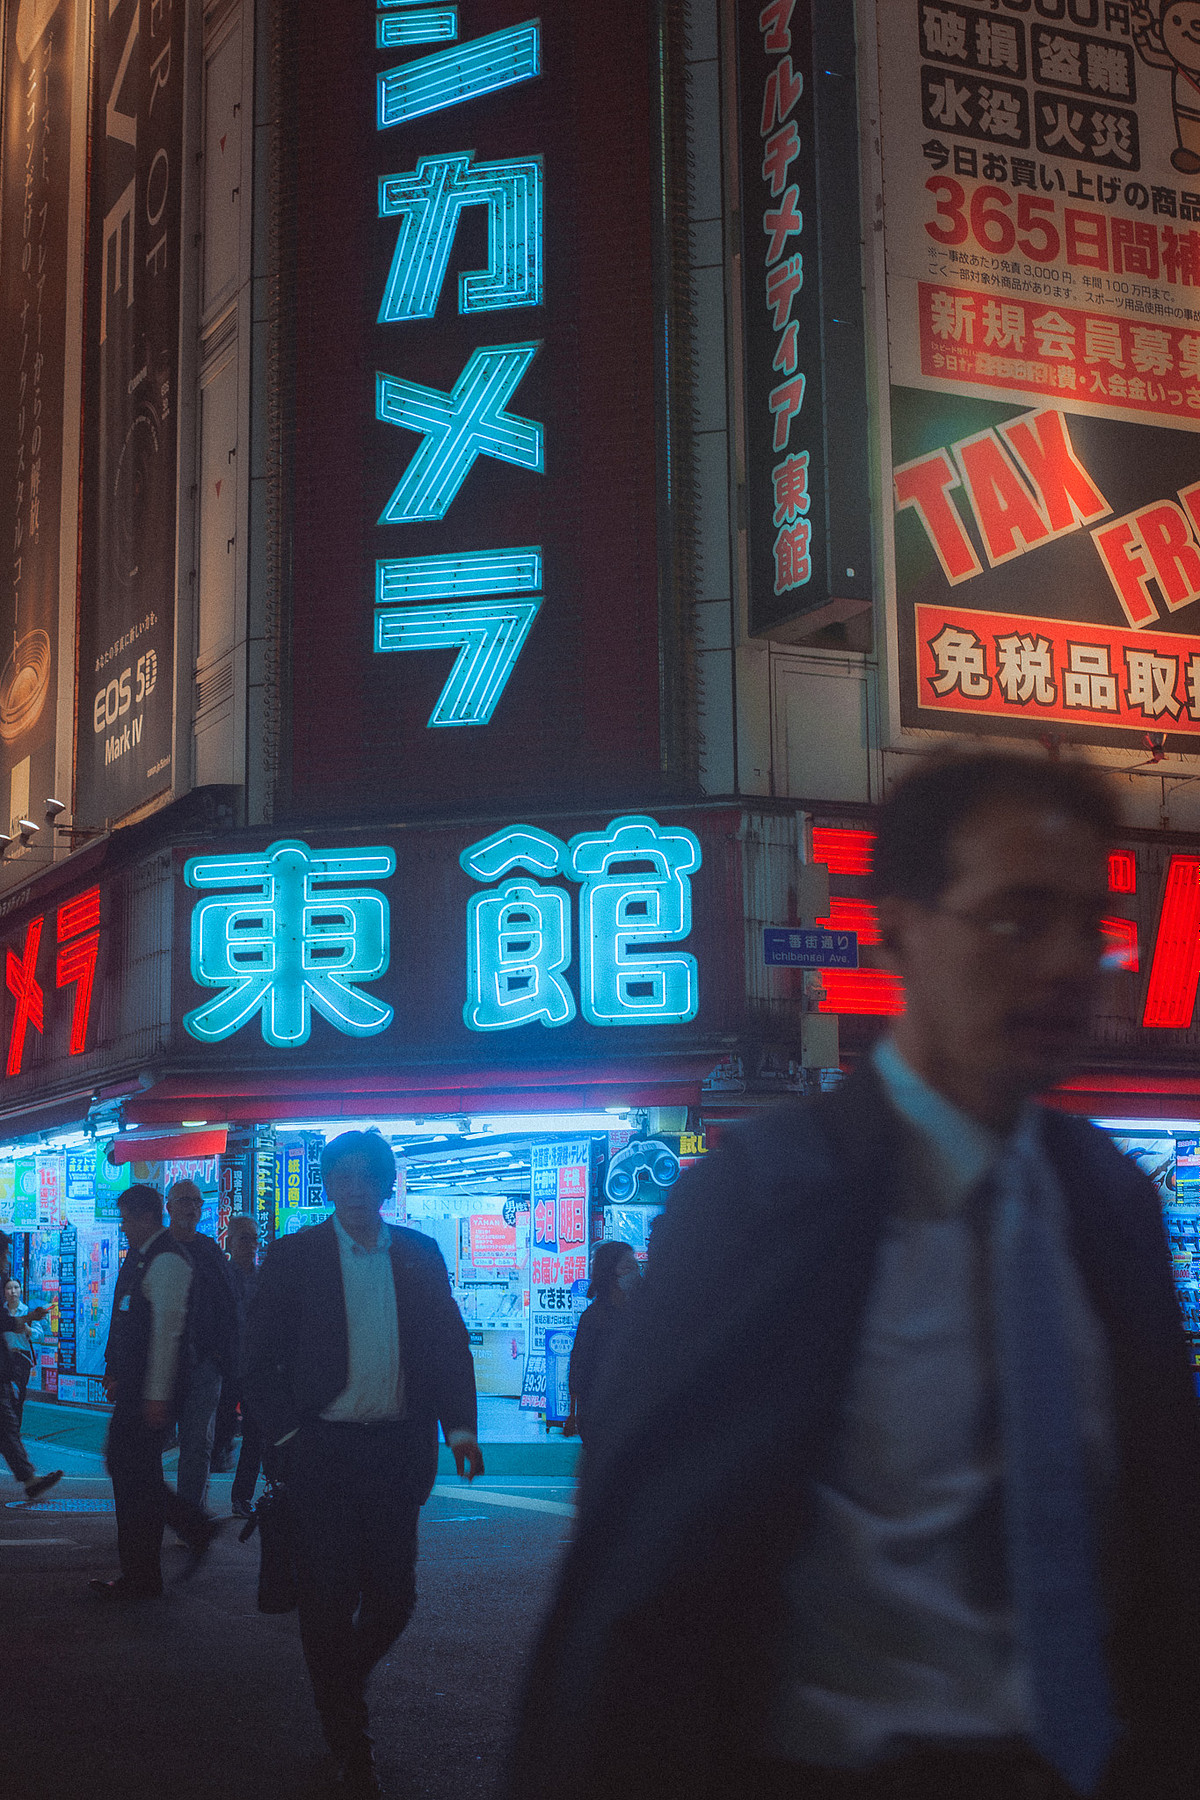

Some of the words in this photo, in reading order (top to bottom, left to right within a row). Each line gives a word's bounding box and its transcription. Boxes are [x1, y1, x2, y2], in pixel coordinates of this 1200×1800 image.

[922, 4, 1020, 73] 破損
[1039, 33, 1132, 96] 盗難
[929, 77, 1023, 140] 水没
[1042, 103, 1133, 163] 火災
[101, 0, 140, 346] VE
[922, 139, 1200, 222] 今日お買い上げの商品
[146, 148, 169, 276] OF
[893, 408, 1114, 587] TAX
[93, 667, 132, 733] EOS
[136, 649, 157, 702] 5D
[105, 724, 131, 766] Mark
[132, 715, 144, 748] IV
[183, 815, 703, 1048] 東館
[772, 934, 849, 951] 一番街通り
[772, 951, 825, 964] Ichibangai
[829, 954, 850, 964] Ave.
[679, 1135, 709, 1155] 試し
[534, 1170, 555, 1188] 午前中
[563, 1168, 580, 1186] 午後
[421, 1199, 482, 1211] KINUJO
[534, 1199, 556, 1243] 今日
[559, 1197, 586, 1243] 明日
[532, 1256, 586, 1284] お届け・設置
